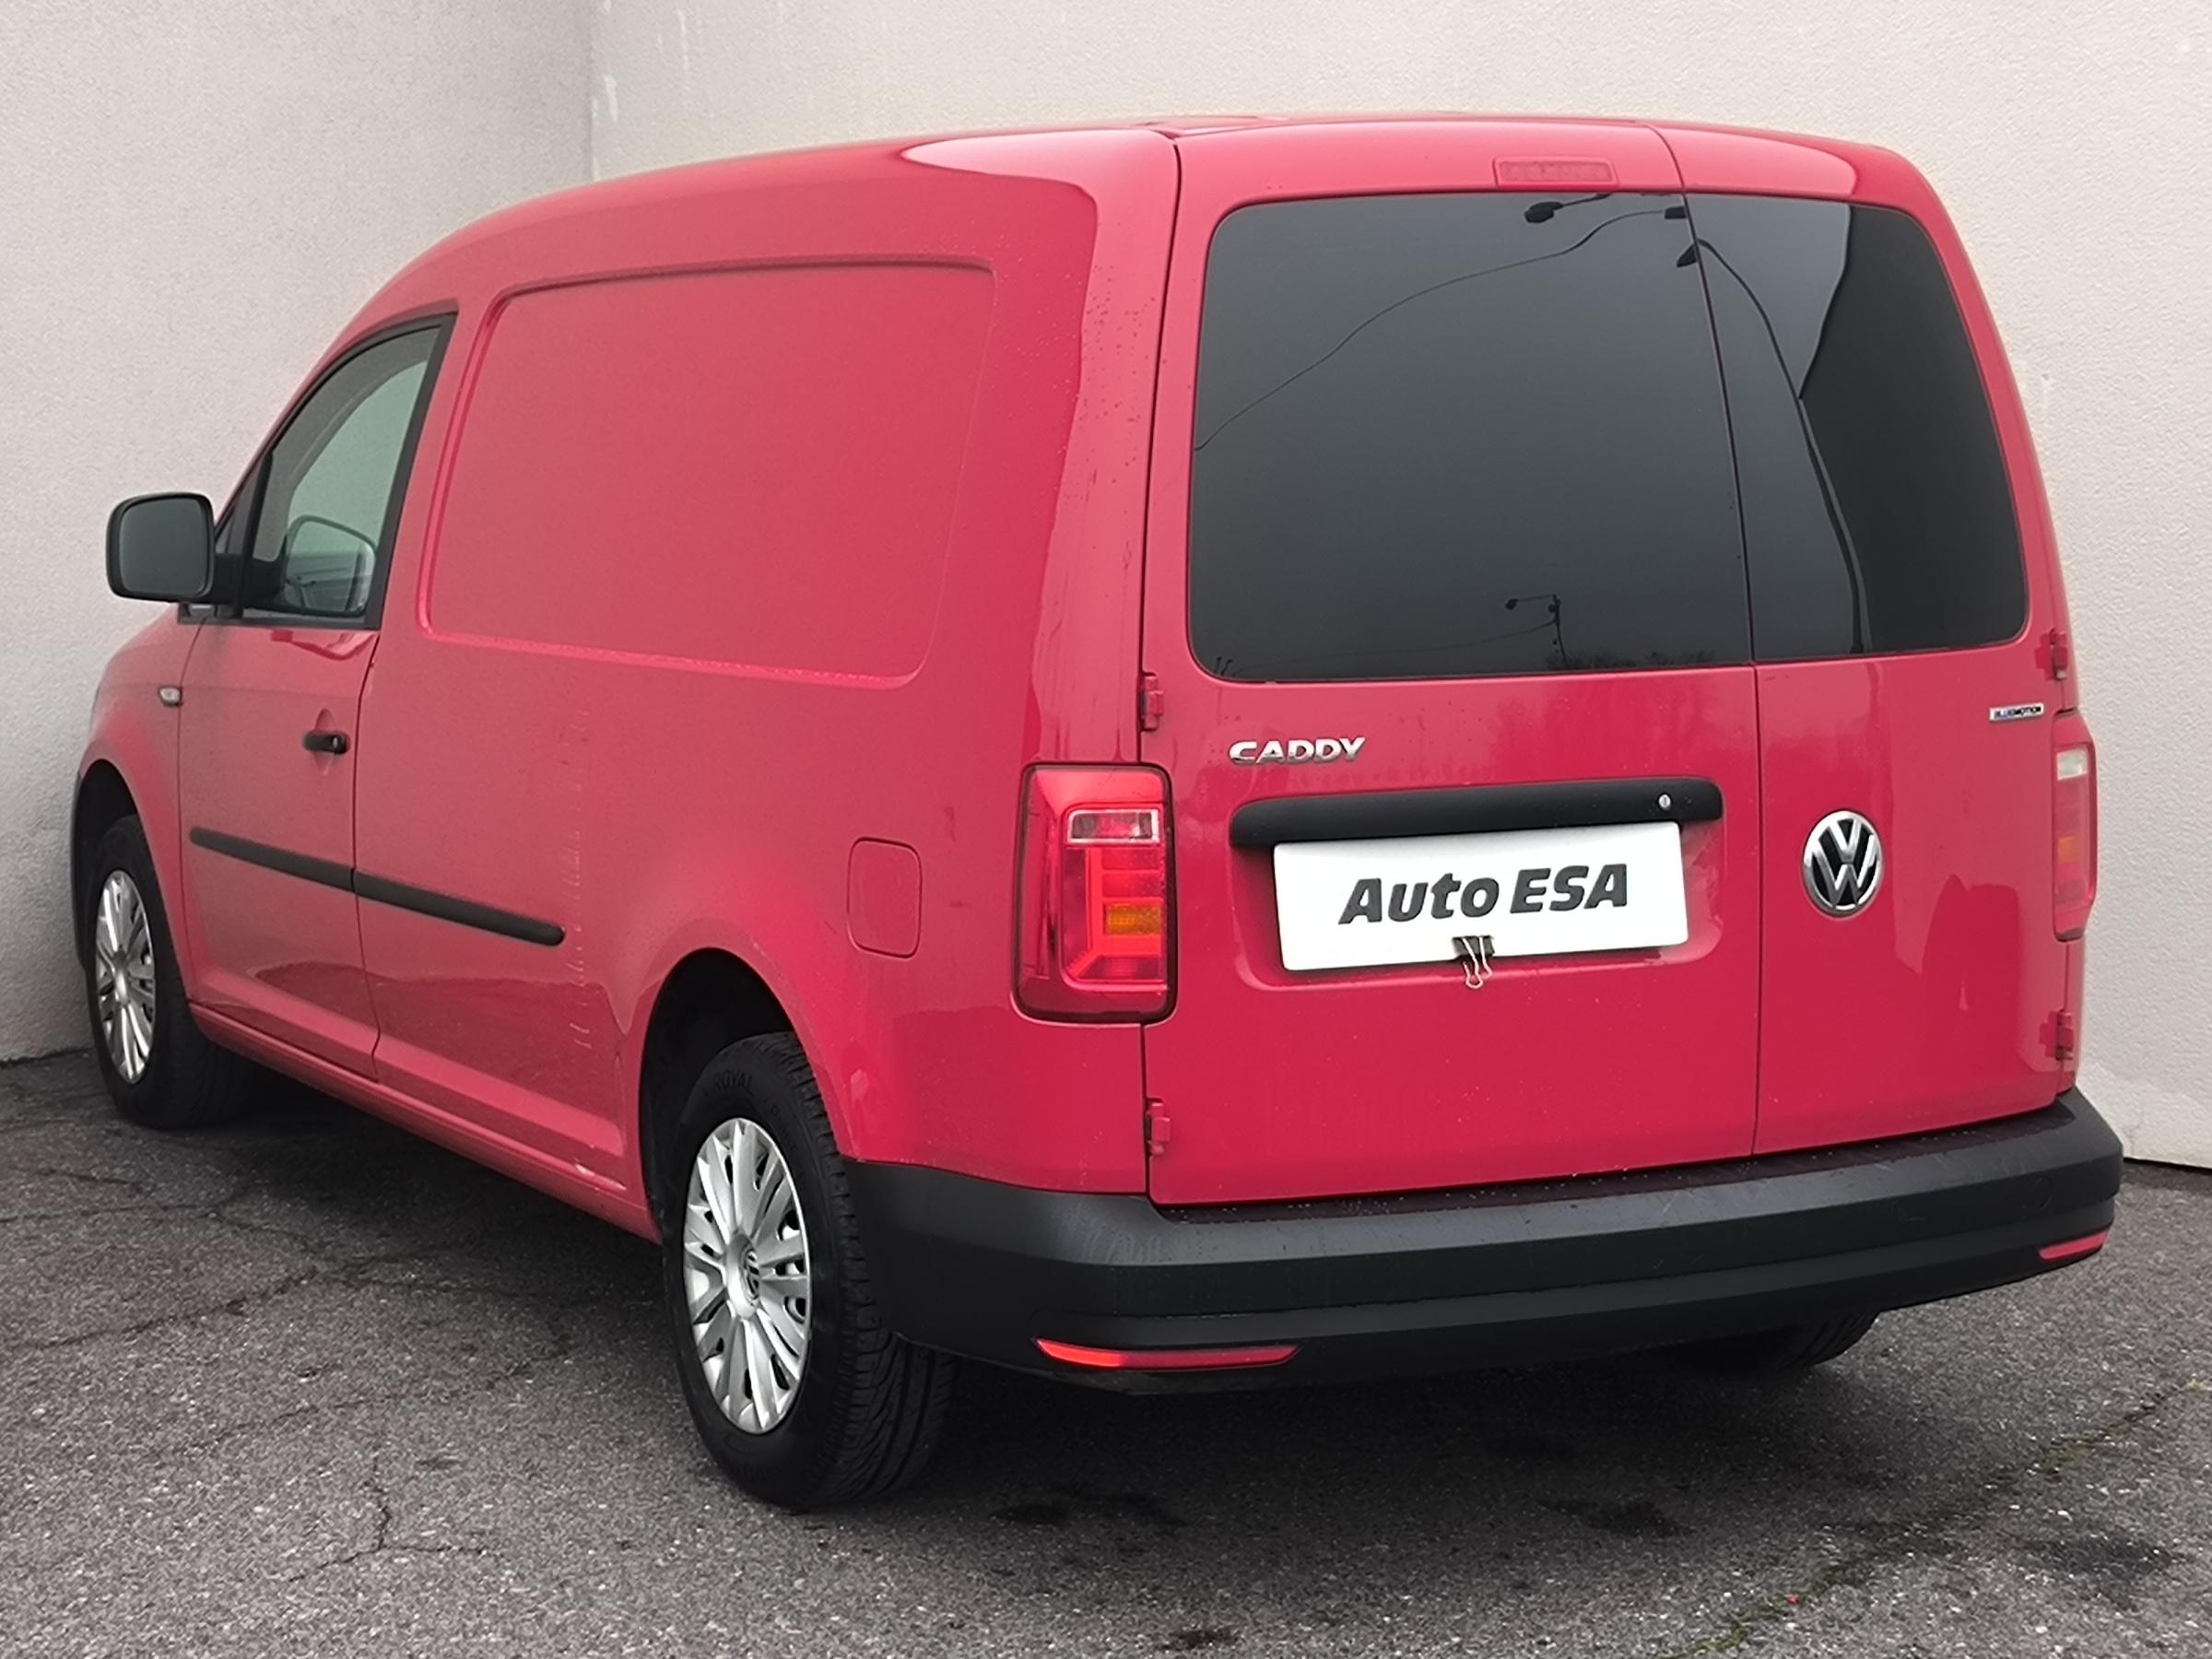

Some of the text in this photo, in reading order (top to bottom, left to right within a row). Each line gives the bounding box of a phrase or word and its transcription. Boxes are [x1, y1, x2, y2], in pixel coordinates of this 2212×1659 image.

[1230, 736, 1366, 765] CADDY
[1338, 864, 1628, 924] Auto ESA
